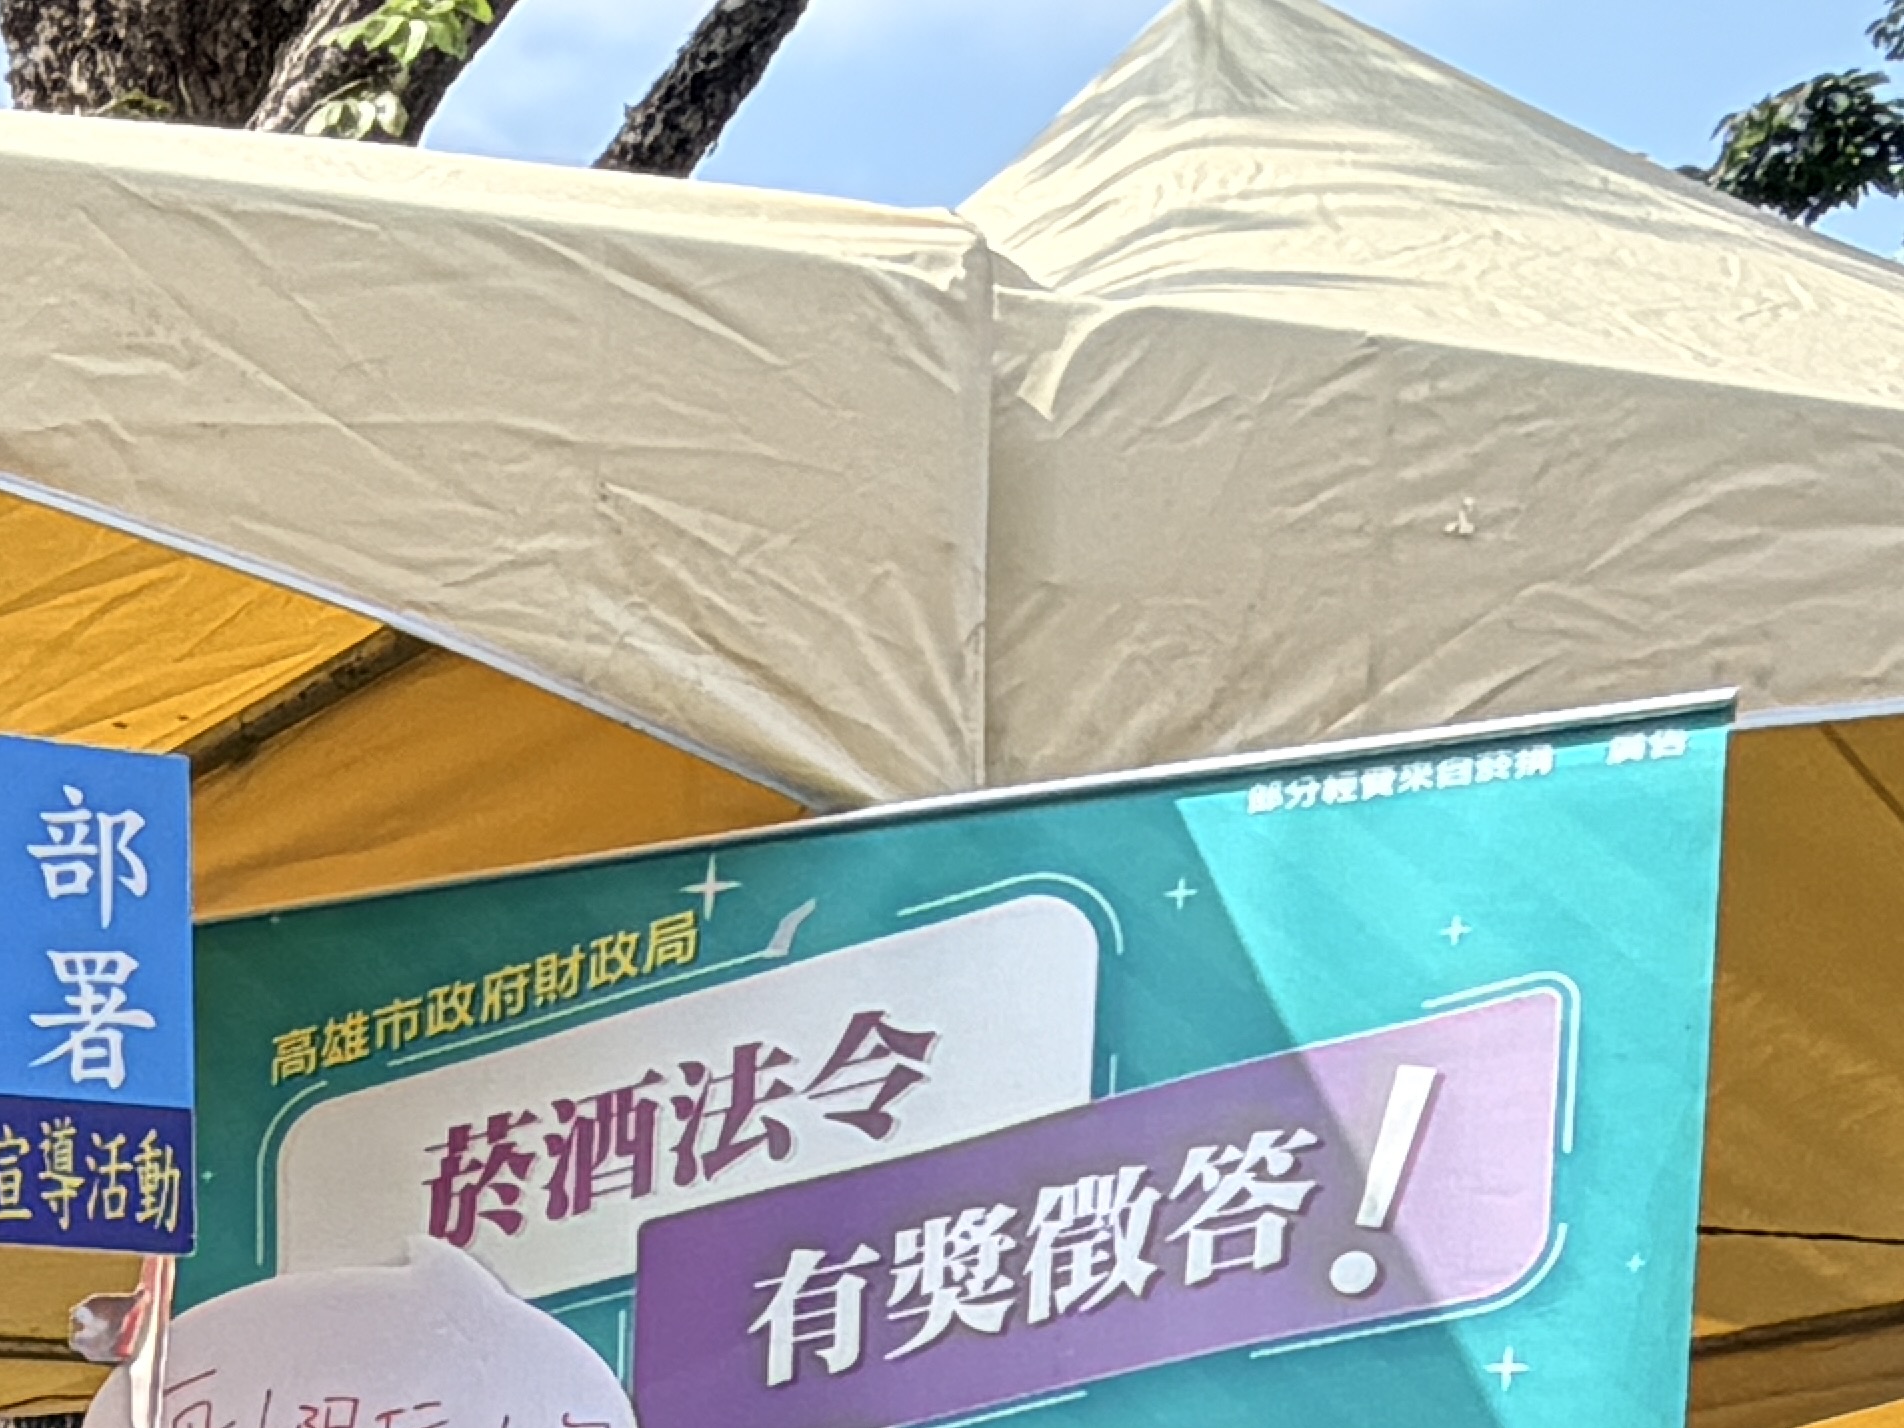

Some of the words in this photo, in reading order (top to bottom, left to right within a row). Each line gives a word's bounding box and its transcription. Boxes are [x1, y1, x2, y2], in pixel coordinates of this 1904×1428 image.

[269, 909, 700, 1087] 高雄市政府財政局
[420, 1009, 943, 1250] 菸酒法令
